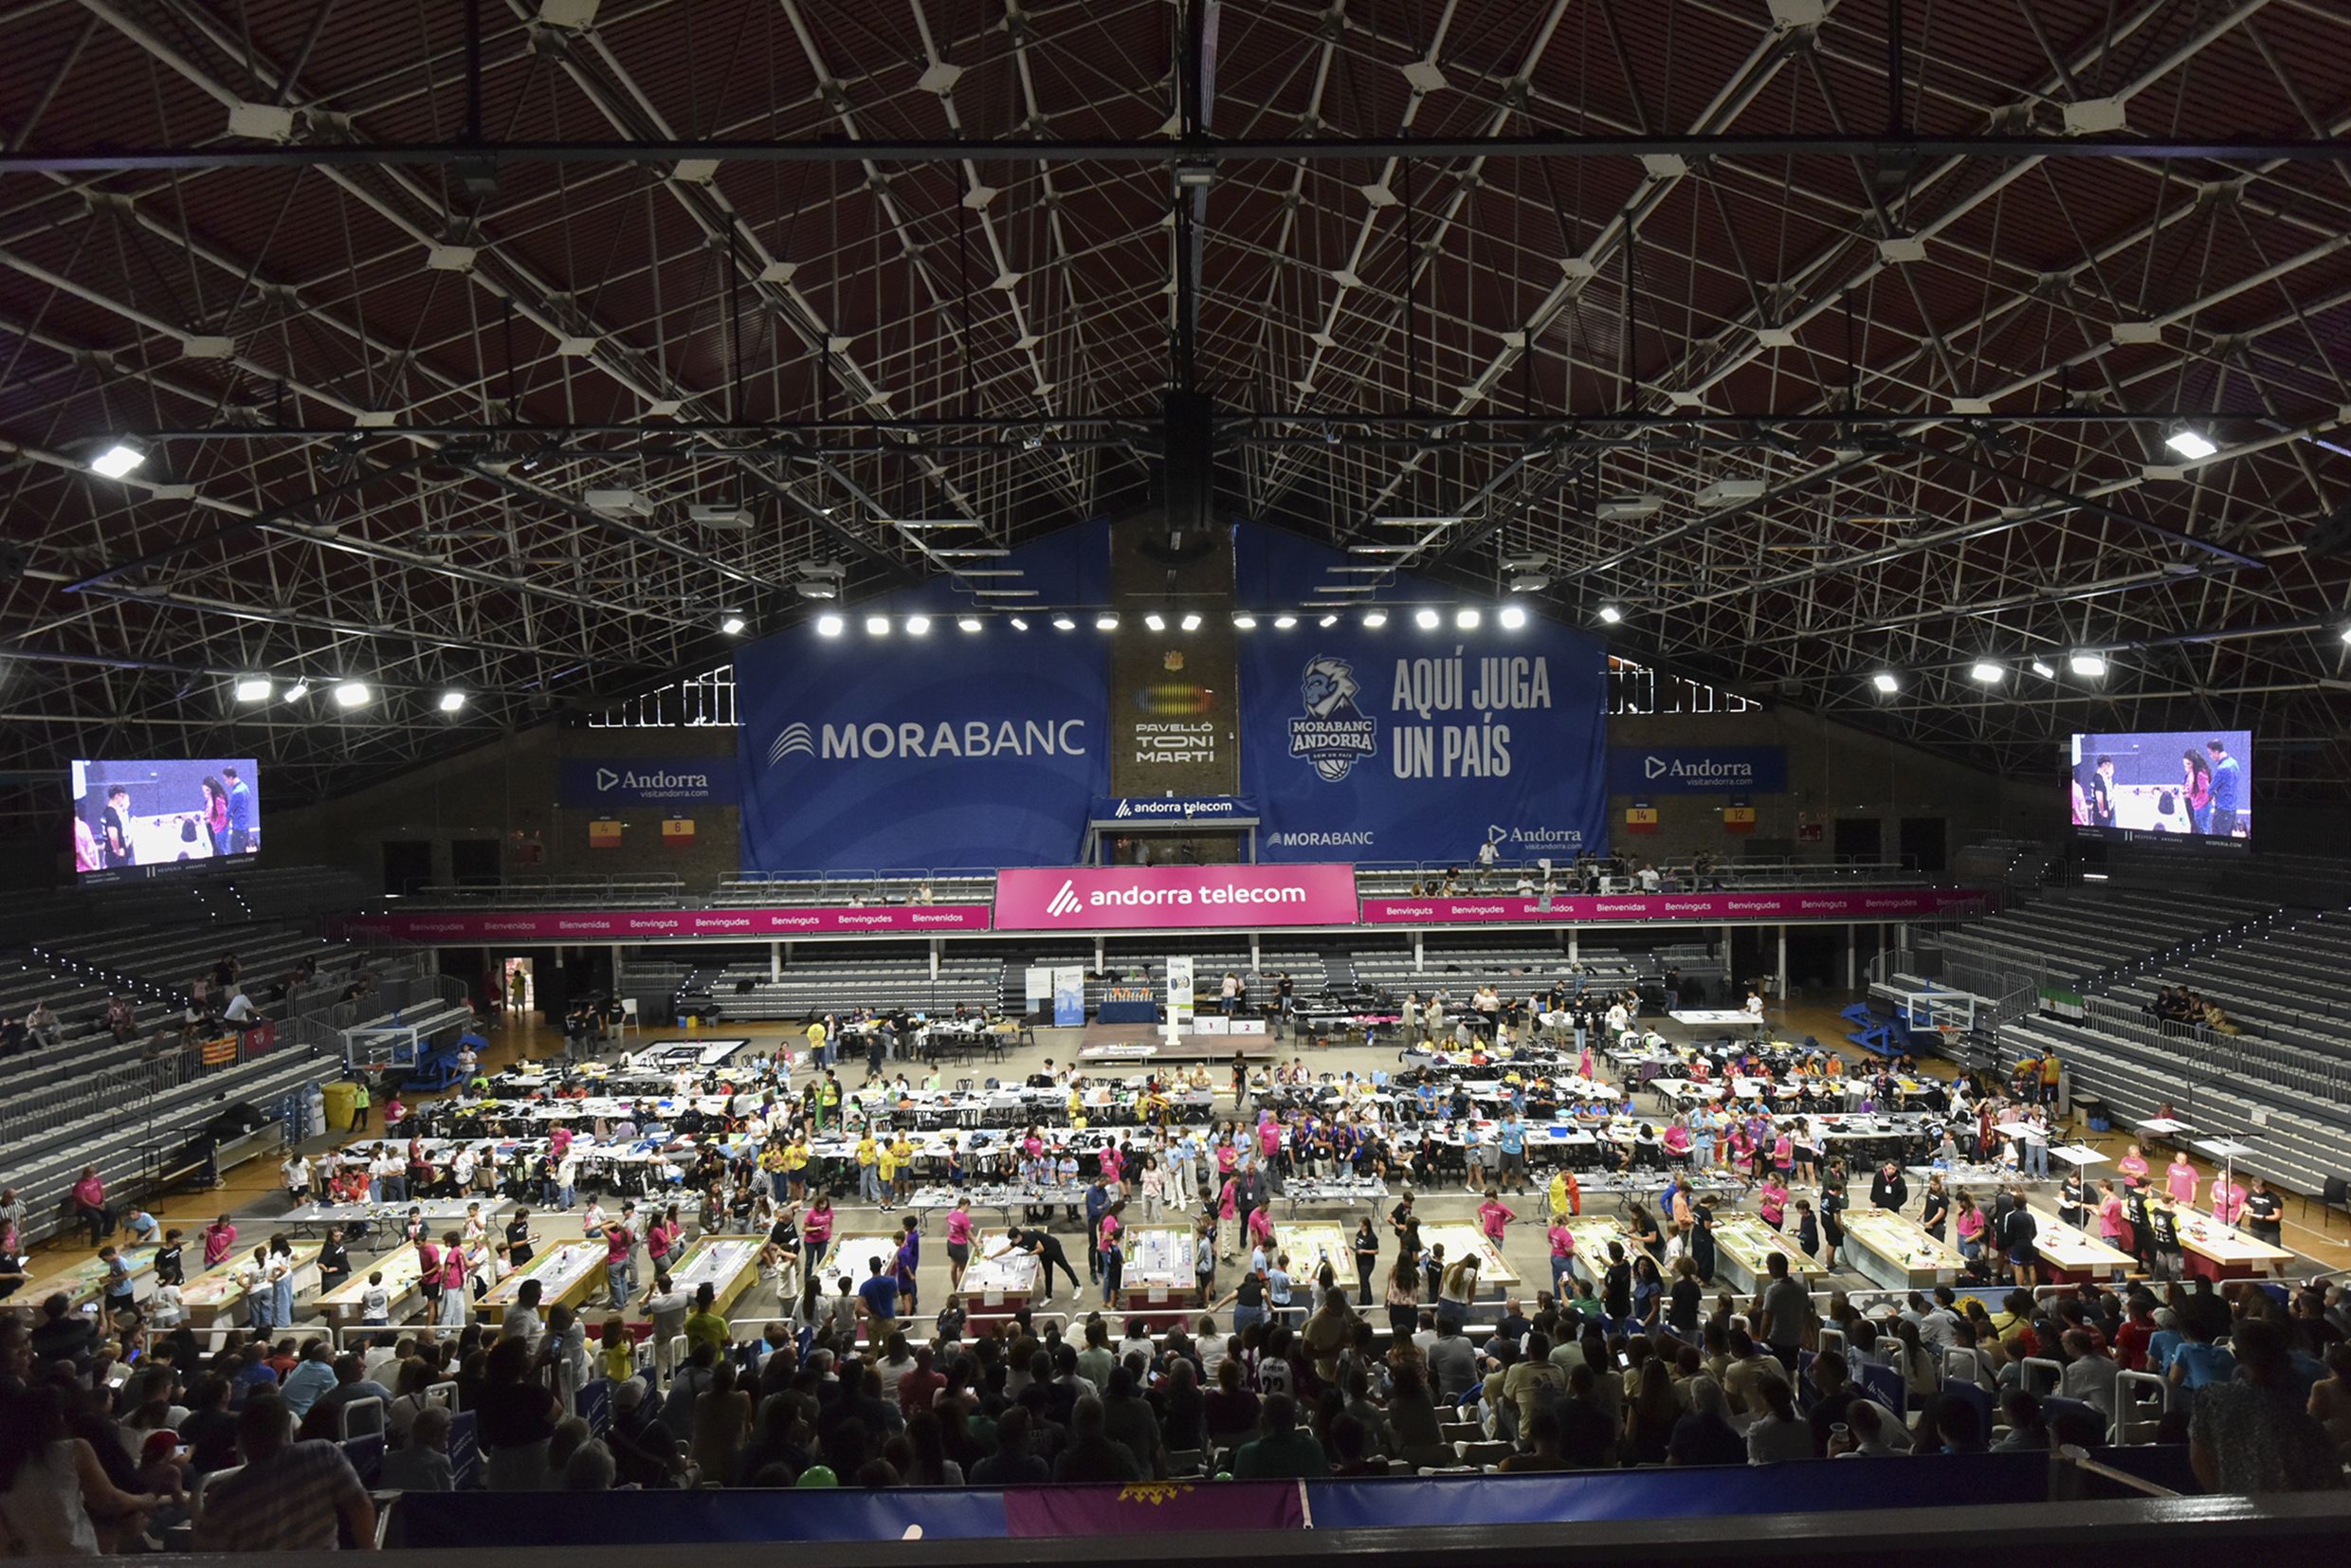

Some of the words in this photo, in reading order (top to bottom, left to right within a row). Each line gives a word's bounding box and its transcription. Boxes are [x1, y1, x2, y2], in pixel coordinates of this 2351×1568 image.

[1393, 645, 1464, 714] AQUÍ
[1472, 656, 1551, 711] JUGA
[1136, 720, 1213, 733] PAVELLÓ
[1293, 720, 1373, 733] MORABANC
[822, 719, 1085, 759] MORABANC
[1136, 736, 1213, 748] TONI
[1293, 733, 1373, 752] ANDORRA
[1394, 727, 1438, 778] UN
[1443, 711, 1510, 777] PAÍS
[1669, 758, 1752, 776] Andorra
[622, 770, 708, 789] Andorra
[1686, 777, 1753, 787] visitandorra.com
[640, 788, 708, 798] visitandorra.com
[1135, 801, 1181, 811] andorra
[1185, 800, 1232, 813] telecom
[1636, 810, 1647, 822] 14
[1734, 810, 1744, 821] 12
[1284, 831, 1374, 846] MORABANC
[1510, 825, 1582, 843] Andorra
[1524, 842, 1582, 850] visitandorra.com
[1090, 885, 1193, 906] andorra
[1198, 884, 1306, 904] telecom
[1386, 905, 1433, 918] Benvinguts
[1450, 904, 1505, 917] Benvingudes
[1523, 903, 1575, 914] Bienidos
[1596, 902, 1647, 913] Bienvenidas
[1665, 901, 1712, 913] Benvinguts
[1727, 900, 1781, 912] Benvingudes
[1801, 899, 1848, 911] Benvinguts
[484, 921, 537, 931] Bienvenidos
[559, 920, 611, 930] Bienvenidas
[629, 919, 679, 930] Benvinguts
[695, 917, 751, 929] Benvingudes
[771, 916, 820, 928] Benvinguts
[838, 914, 893, 926] Benvingudes
[912, 913, 964, 923] Bienvenidos
